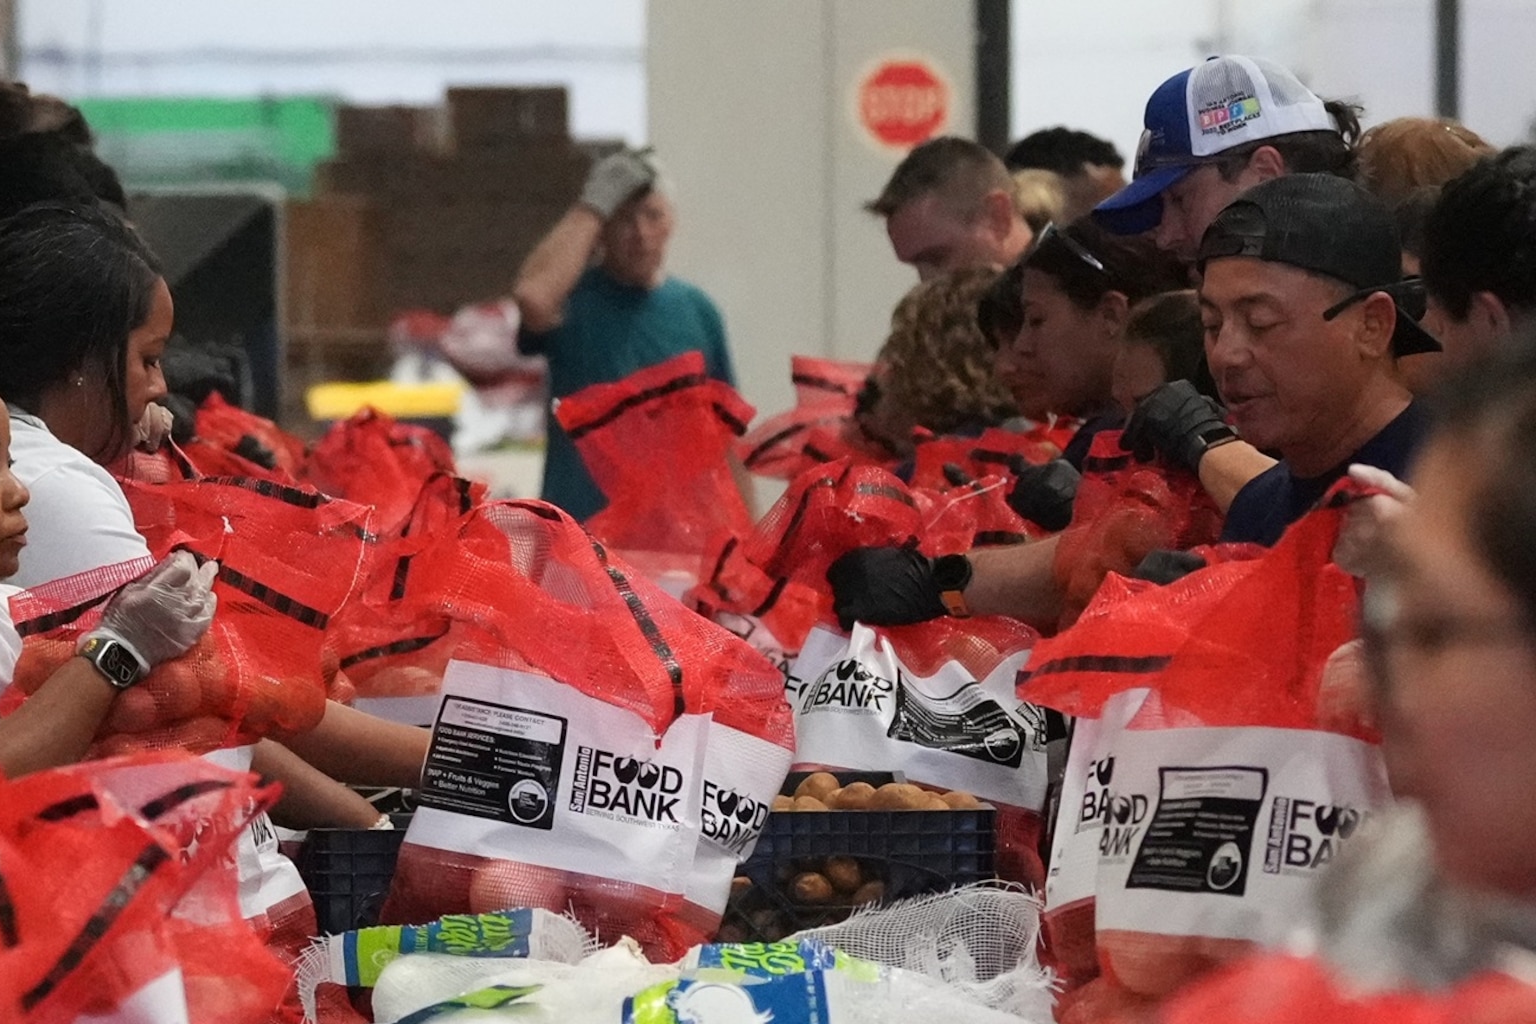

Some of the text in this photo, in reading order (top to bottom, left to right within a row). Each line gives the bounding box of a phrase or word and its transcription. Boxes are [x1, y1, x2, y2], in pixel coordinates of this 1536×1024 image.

[867, 86, 938, 121] STOP
[814, 682, 889, 711] BANK
[438, 780, 486, 796] Better Nutrition
[448, 769, 466, 781] Fruits
[473, 777, 500, 789] Veggies
[570, 746, 592, 813] San Antonio
[592, 749, 683, 795] FOOD
[585, 807, 614, 821] SERVING
[587, 779, 680, 823] BANK
[702, 779, 769, 832] FOOD
[1289, 799, 1360, 840] FOO
[700, 808, 759, 856] BANK
[1285, 833, 1334, 869] BA
